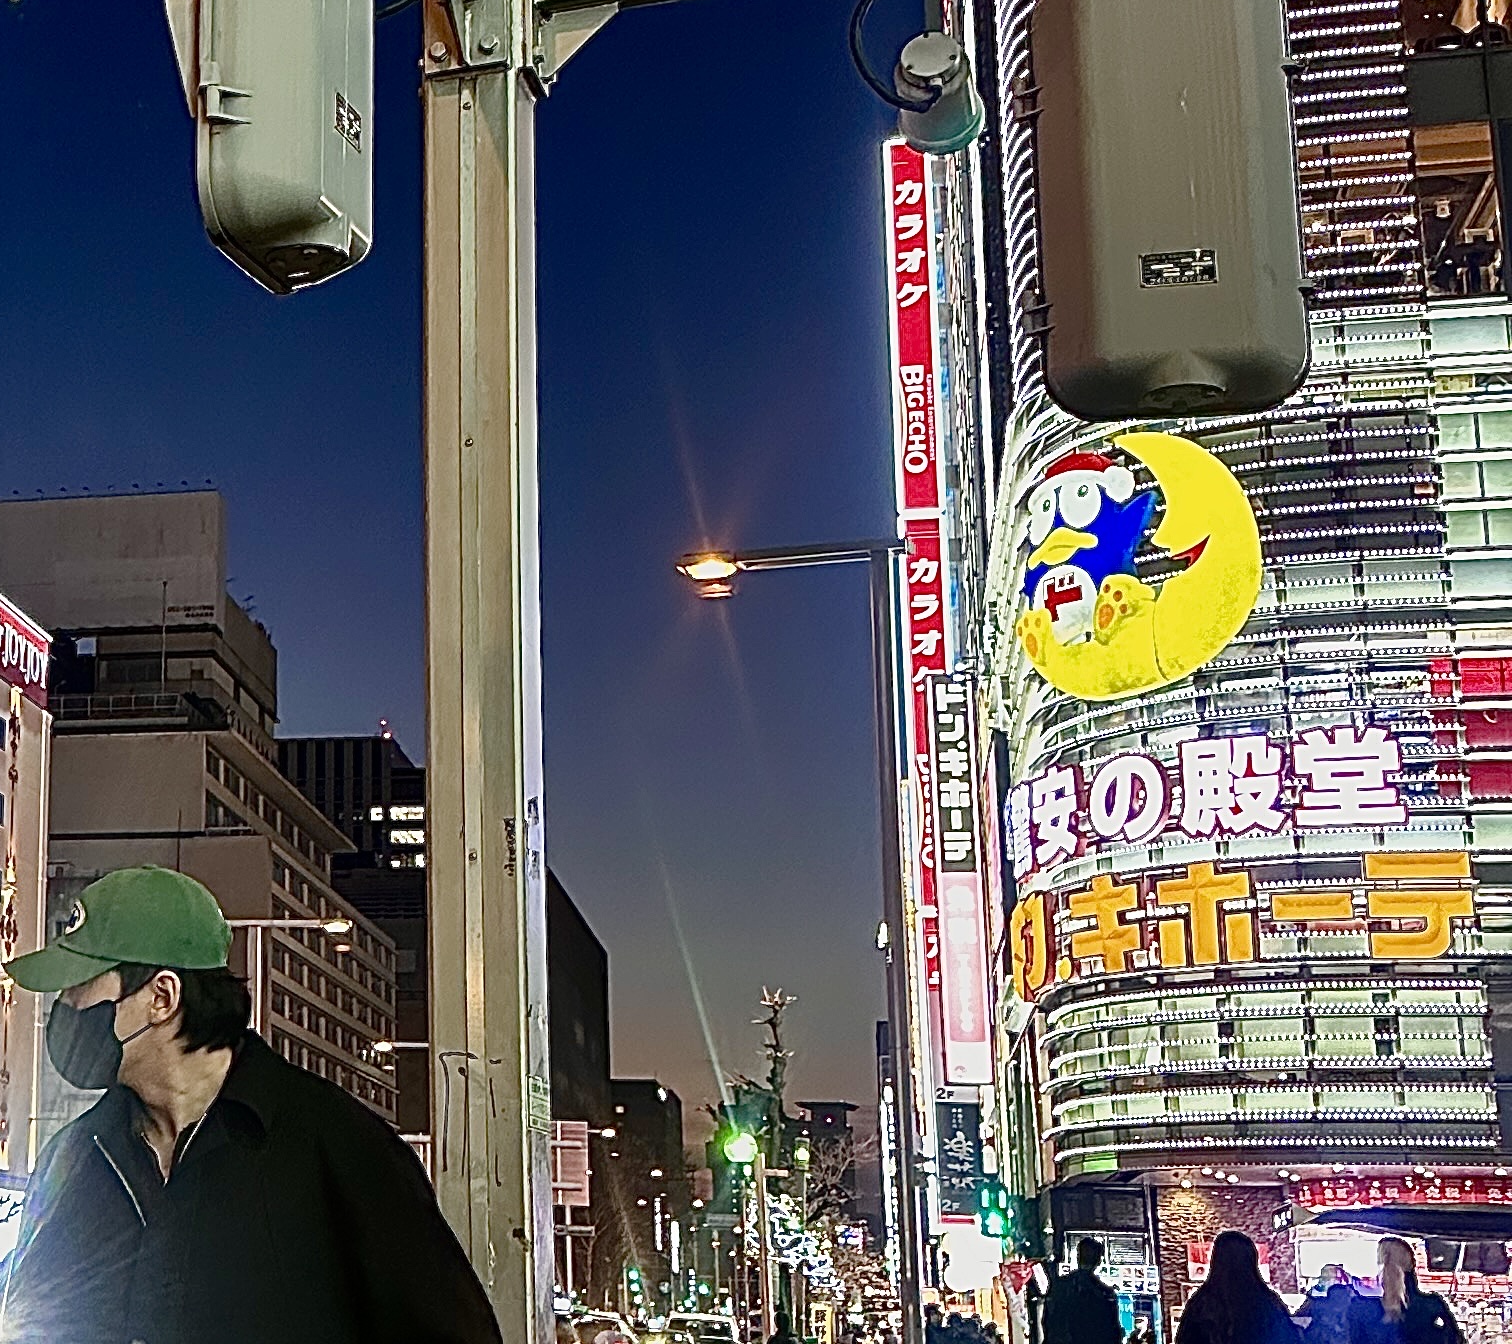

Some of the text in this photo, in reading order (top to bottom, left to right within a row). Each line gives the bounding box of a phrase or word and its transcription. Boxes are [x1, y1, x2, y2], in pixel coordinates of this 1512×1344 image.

[894, 179, 929, 309] カラオケ
[899, 364, 930, 475] BIG ECHO
[936, 1087, 955, 1100] 2F
